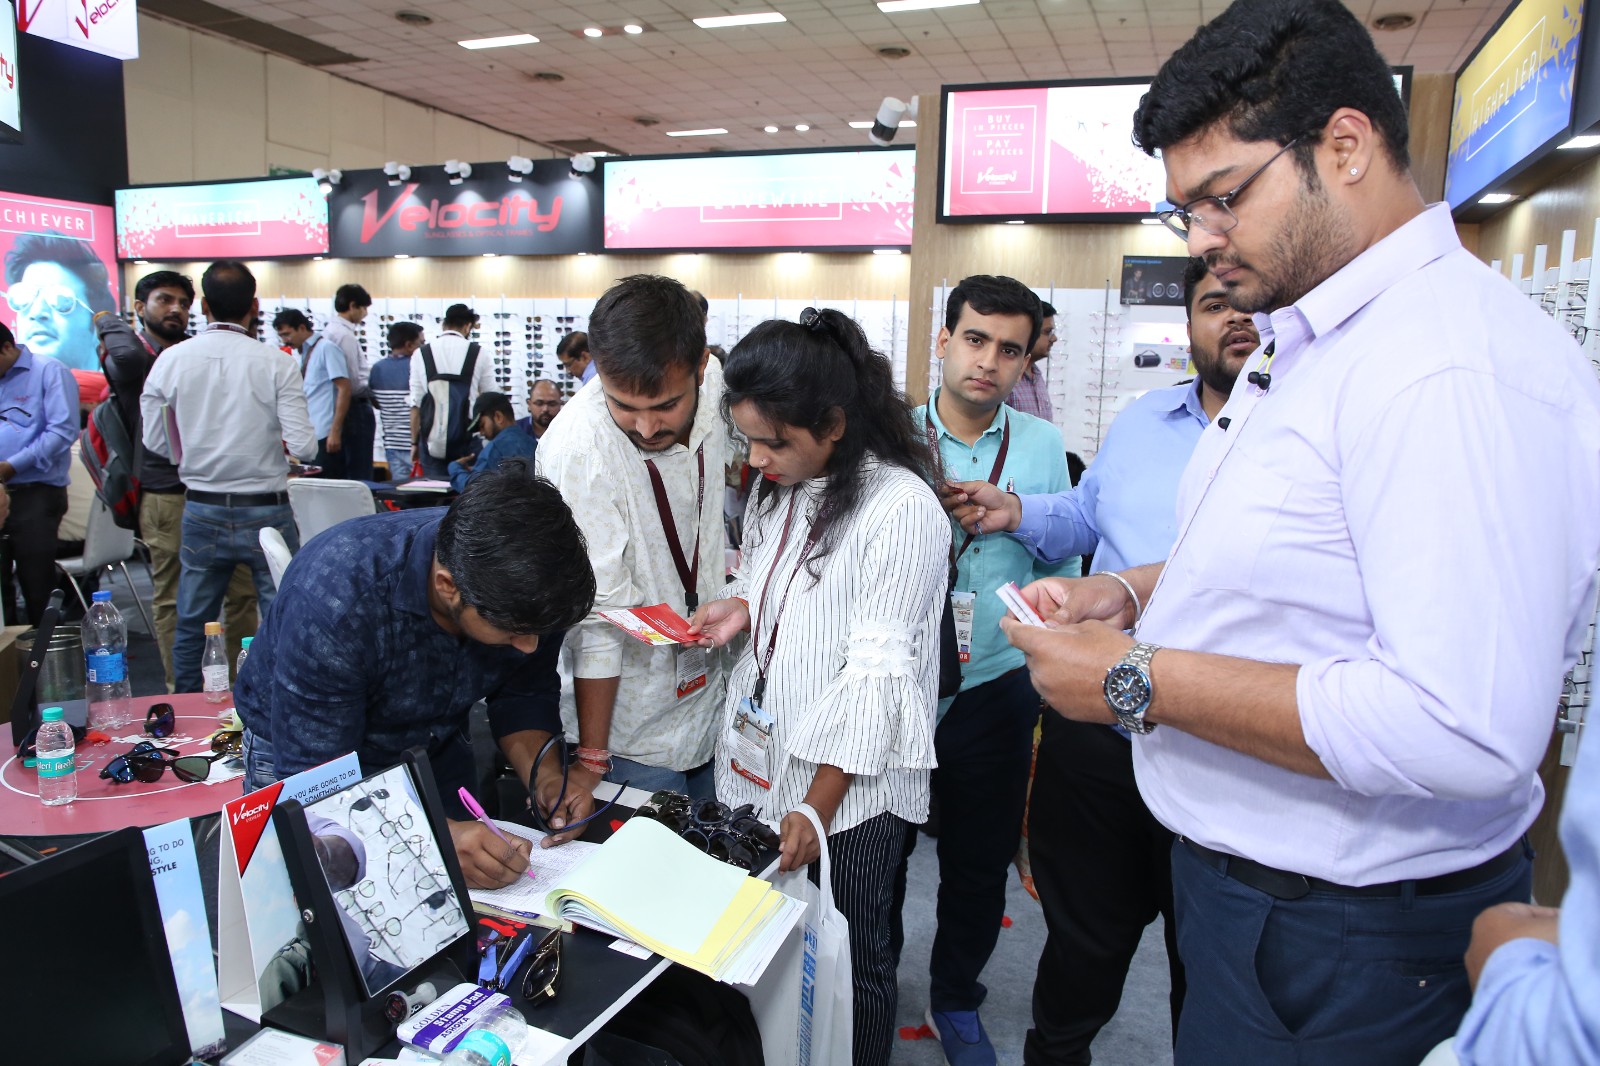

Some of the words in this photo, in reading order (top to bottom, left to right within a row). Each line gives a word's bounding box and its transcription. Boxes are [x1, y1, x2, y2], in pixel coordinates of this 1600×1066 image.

[1472, 50, 1537, 137] HIGHFLIER
[987, 114, 1011, 124] BUY
[990, 123, 1024, 131] PIECES
[986, 139, 1010, 148] PAY
[989, 148, 1024, 156] PIECES
[0, 208, 84, 231] CHIEVER
[360, 183, 563, 243] Velocity
[294, 789, 307, 800] YOU
[308, 784, 320, 793] ARE
[320, 777, 339, 789] GOING
[339, 773, 347, 781] TO
[347, 769, 356, 778] DO
[233, 802, 269, 825] Velocity
[158, 843, 170, 852] TO
[172, 838, 184, 848] DO
[412, 1003, 452, 1030] GOLDEN
[433, 1003, 468, 1027] Stamp
[462, 991, 484, 1005] Pad
[441, 1017, 471, 1038] ASHOKA
